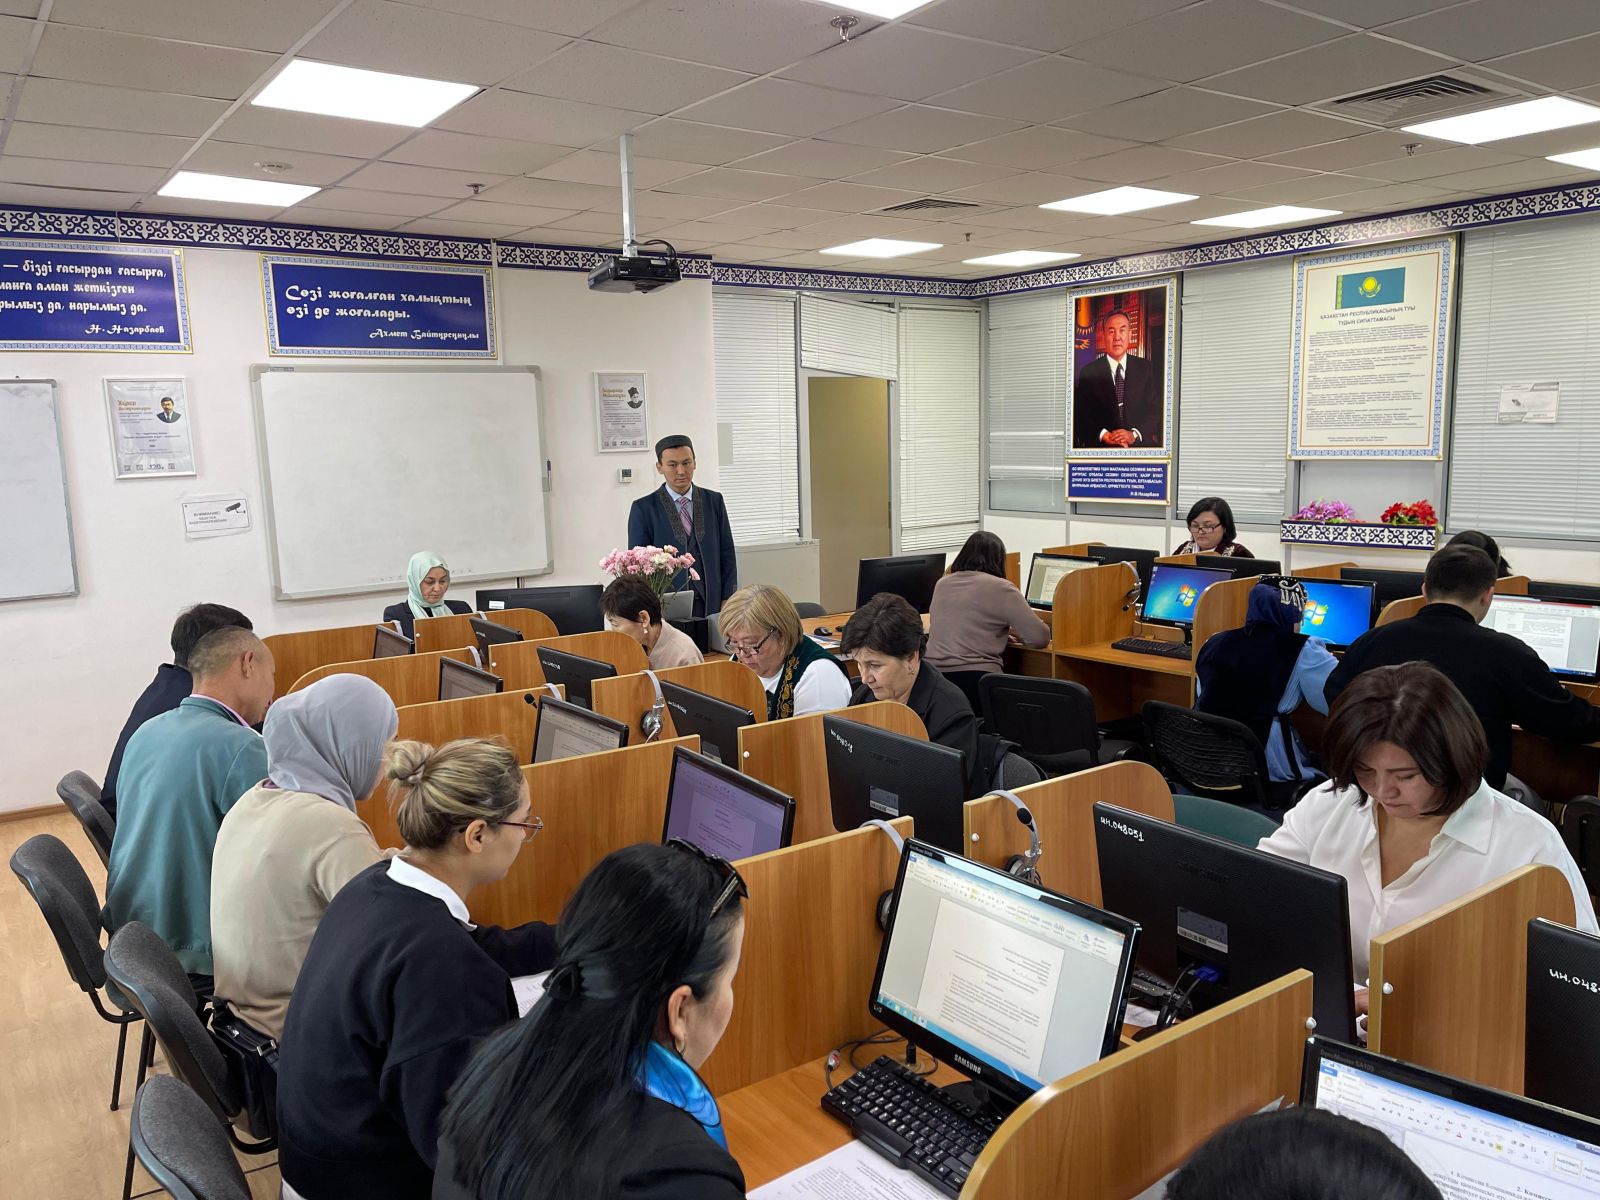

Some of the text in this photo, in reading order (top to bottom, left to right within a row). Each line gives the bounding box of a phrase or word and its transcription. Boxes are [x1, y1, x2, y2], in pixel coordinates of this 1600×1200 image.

[23, 260, 52, 276] бізді
[56, 265, 112, 278] ғасырдан
[118, 268, 166, 280] ғасырға,
[37, 283, 68, 291] аман
[74, 282, 134, 297] жеткізген
[286, 285, 472, 306] Сөзі жоғалған халықтың
[48, 302, 64, 313] да,
[69, 302, 126, 315] нарымыз
[131, 304, 146, 315] да.
[287, 304, 410, 321] өзі де жоғалады.
[370, 329, 407, 338] Ахмет
[954, 1053, 982, 1075] SAMSUNG
